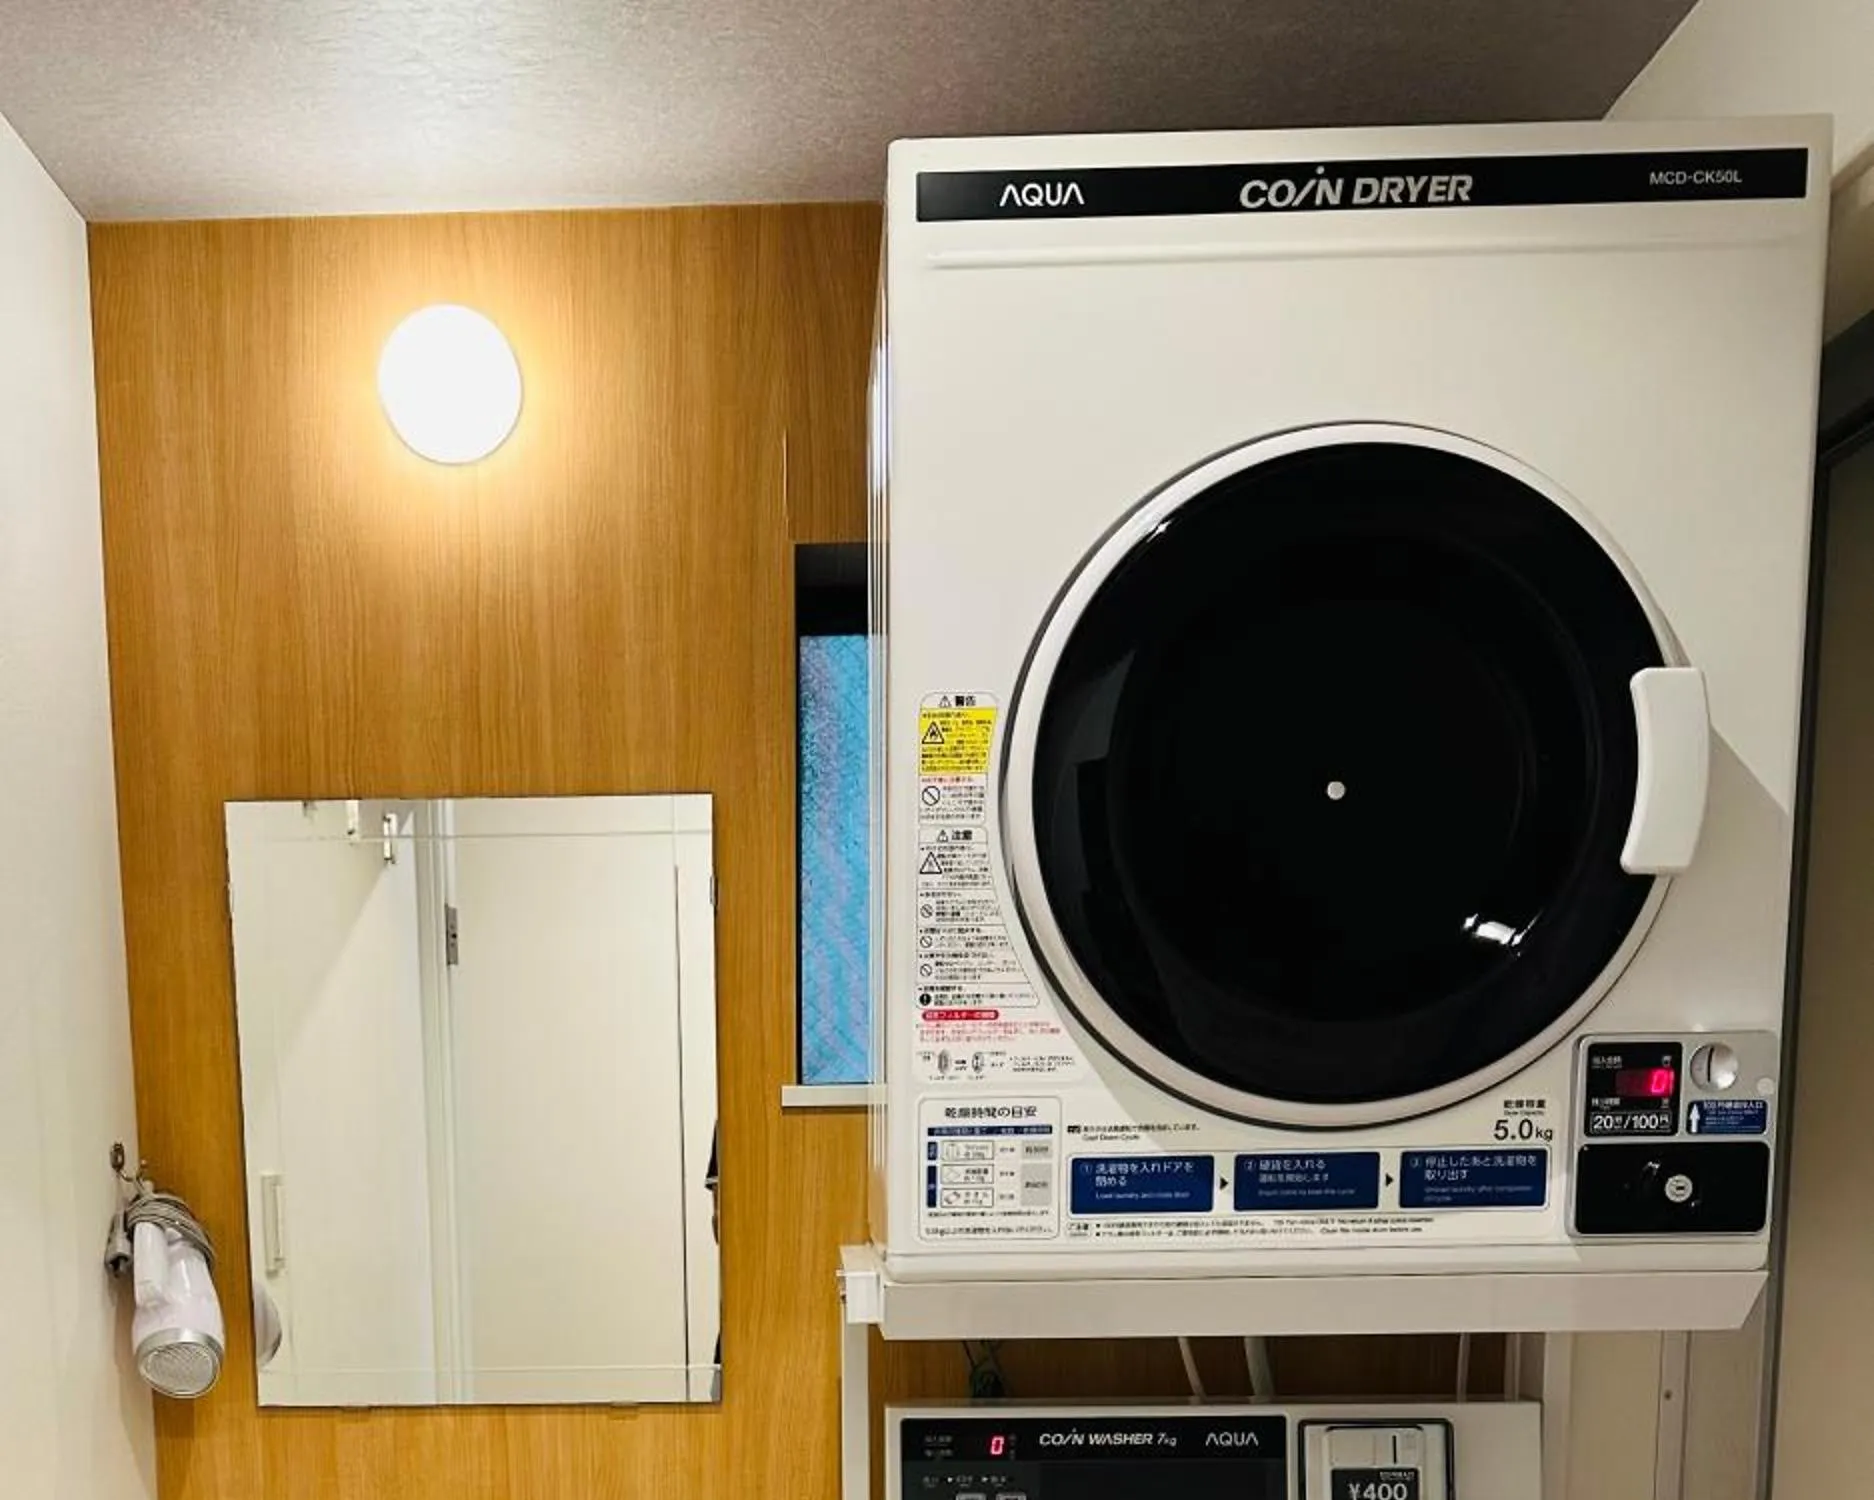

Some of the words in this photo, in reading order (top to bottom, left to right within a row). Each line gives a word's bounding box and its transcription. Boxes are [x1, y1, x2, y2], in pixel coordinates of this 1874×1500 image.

[1238, 165, 1343, 209] COIN
[1351, 174, 1474, 205] DRYER
[1648, 169, 1744, 186] MCD-CK50L
[1000, 182, 1085, 207] AQUA
[990, 1434, 1005, 1455] 0
[1038, 1427, 1085, 1446] COIN
[1088, 1432, 1153, 1445] WASHER
[1205, 1431, 1259, 1447] AQUA
